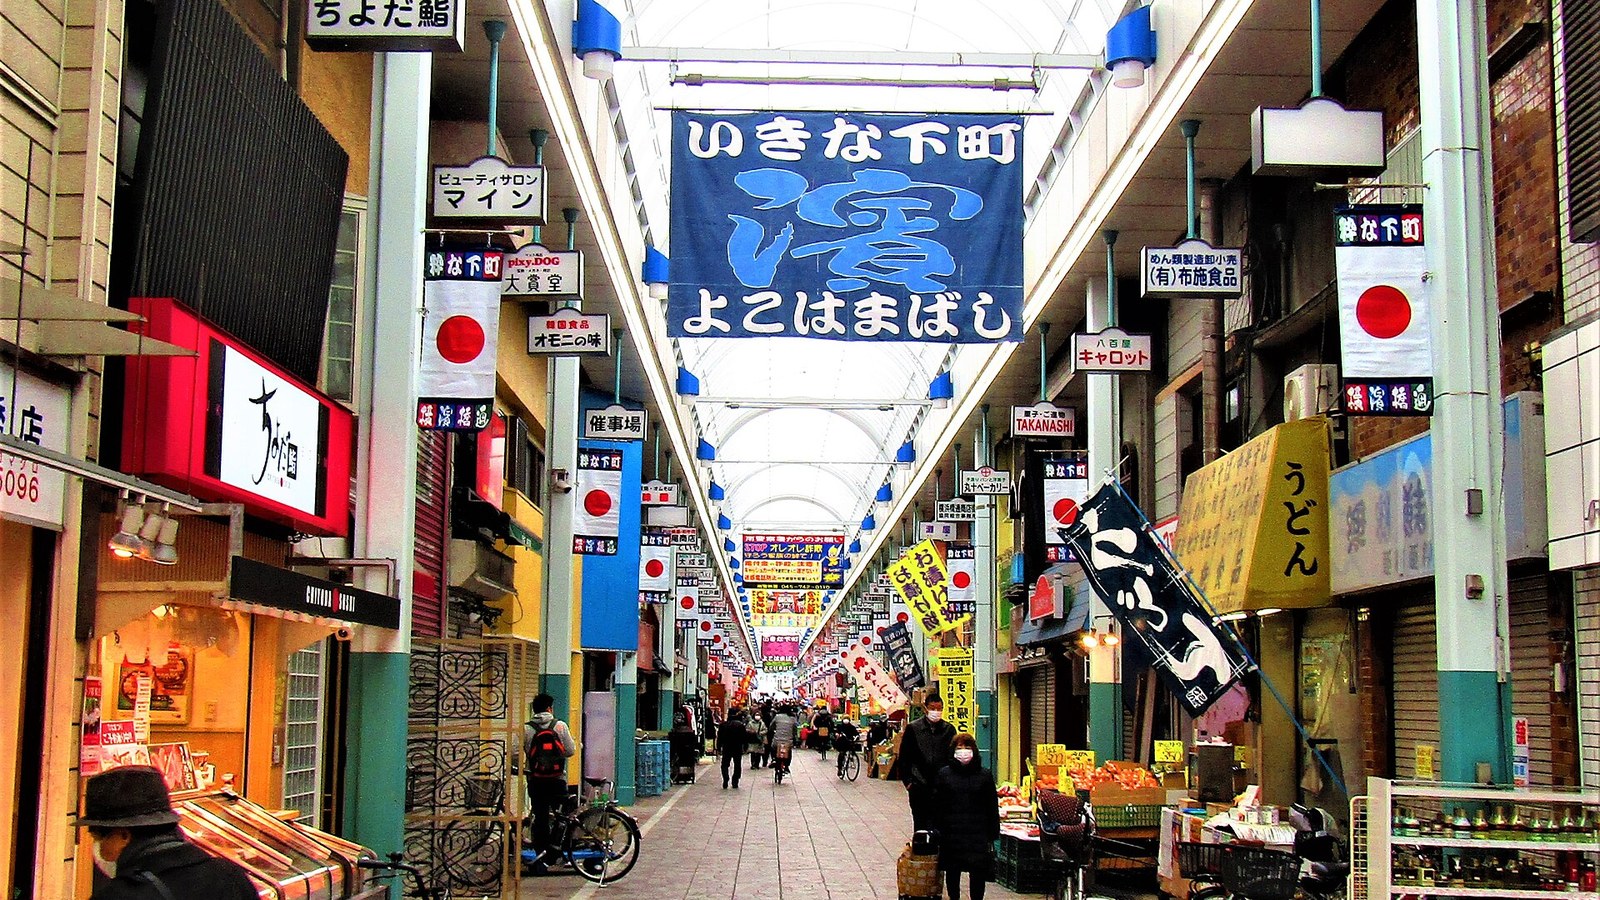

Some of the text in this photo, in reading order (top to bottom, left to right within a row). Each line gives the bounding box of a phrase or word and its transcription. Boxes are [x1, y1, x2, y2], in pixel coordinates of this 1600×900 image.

[313, 0, 449, 27] ちよだ鮨
[687, 116, 1021, 165] いきな下町
[439, 173, 538, 186] ビューティサロン
[443, 189, 533, 209] マイン
[1337, 216, 1420, 242] 粋な下町
[429, 253, 500, 278] 粋な下町
[507, 256, 560, 268] pixy.DOG
[1150, 254, 1237, 265] めん類製造卸小売
[1150, 266, 1237, 287] (有)布施食品
[682, 288, 1013, 340] よこはまばし
[546, 320, 590, 329] 韓国食品
[534, 332, 602, 348] オモニの味
[1096, 339, 1131, 349] 八百屋
[1078, 349, 1148, 366] キャロット
[590, 415, 642, 433] 催事場
[1016, 418, 1073, 433] TAKANASHI
[0, 466, 39, 503] 096
[1283, 461, 1318, 577] うどん
[744, 543, 823, 553] STOP オレオレ詐欺
